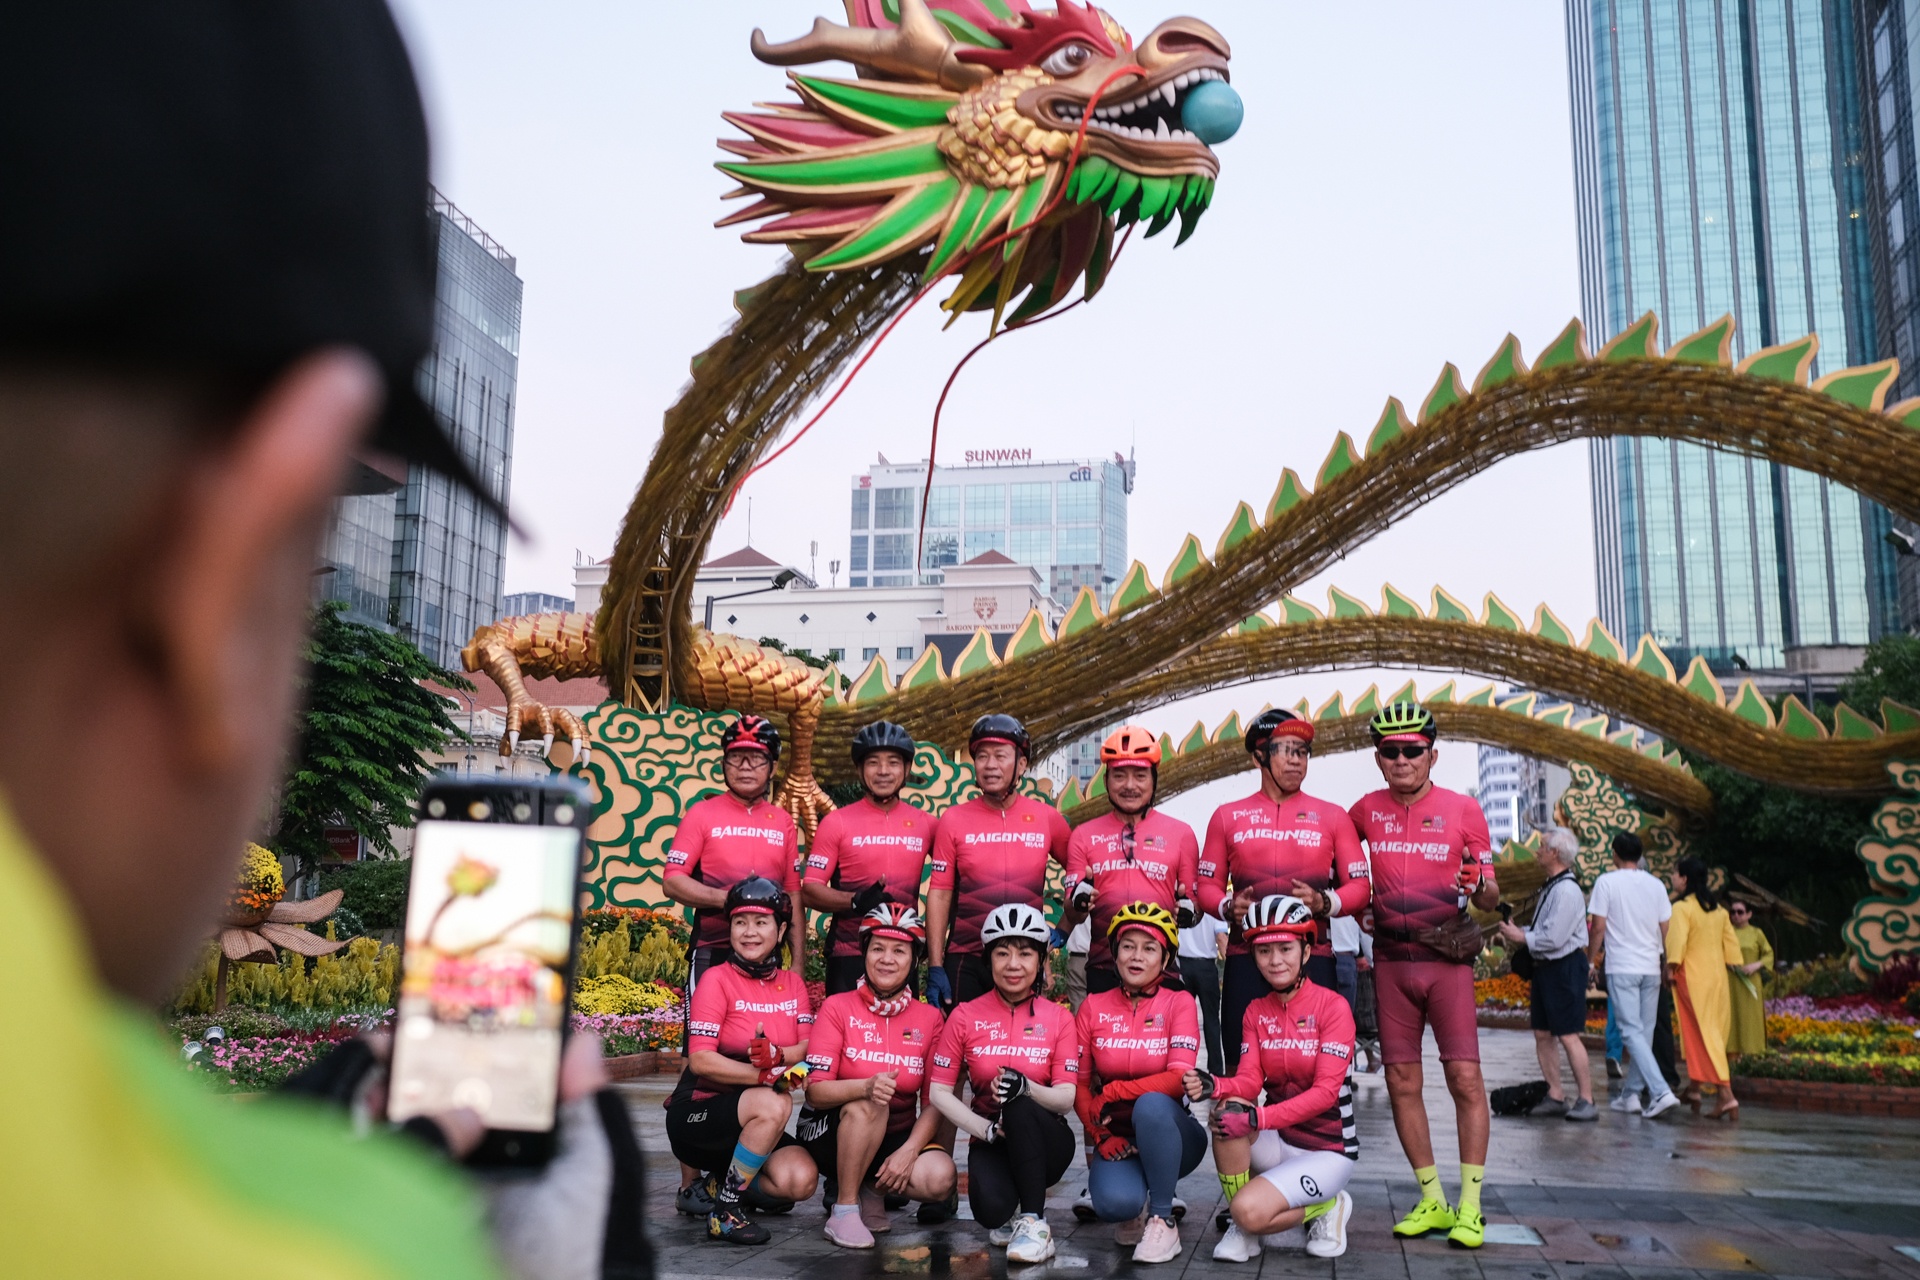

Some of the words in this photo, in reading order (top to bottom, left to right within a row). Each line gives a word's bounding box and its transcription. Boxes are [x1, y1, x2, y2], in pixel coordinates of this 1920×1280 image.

[965, 448, 1032, 463] SUNWAH
[1069, 467, 1092, 482] citi
[946, 624, 972, 632] SAIGON
[711, 825, 785, 841] SAIGON69
[965, 832, 1045, 846] SAIGON69
[1233, 828, 1323, 844] SAIGON69
[852, 835, 923, 847] SAIGON69
[1371, 840, 1450, 855] SAIGON69
[690, 1020, 721, 1032] SG69
[1096, 1037, 1168, 1050] SAIGON69
[972, 1044, 1051, 1058] SAIGON69
